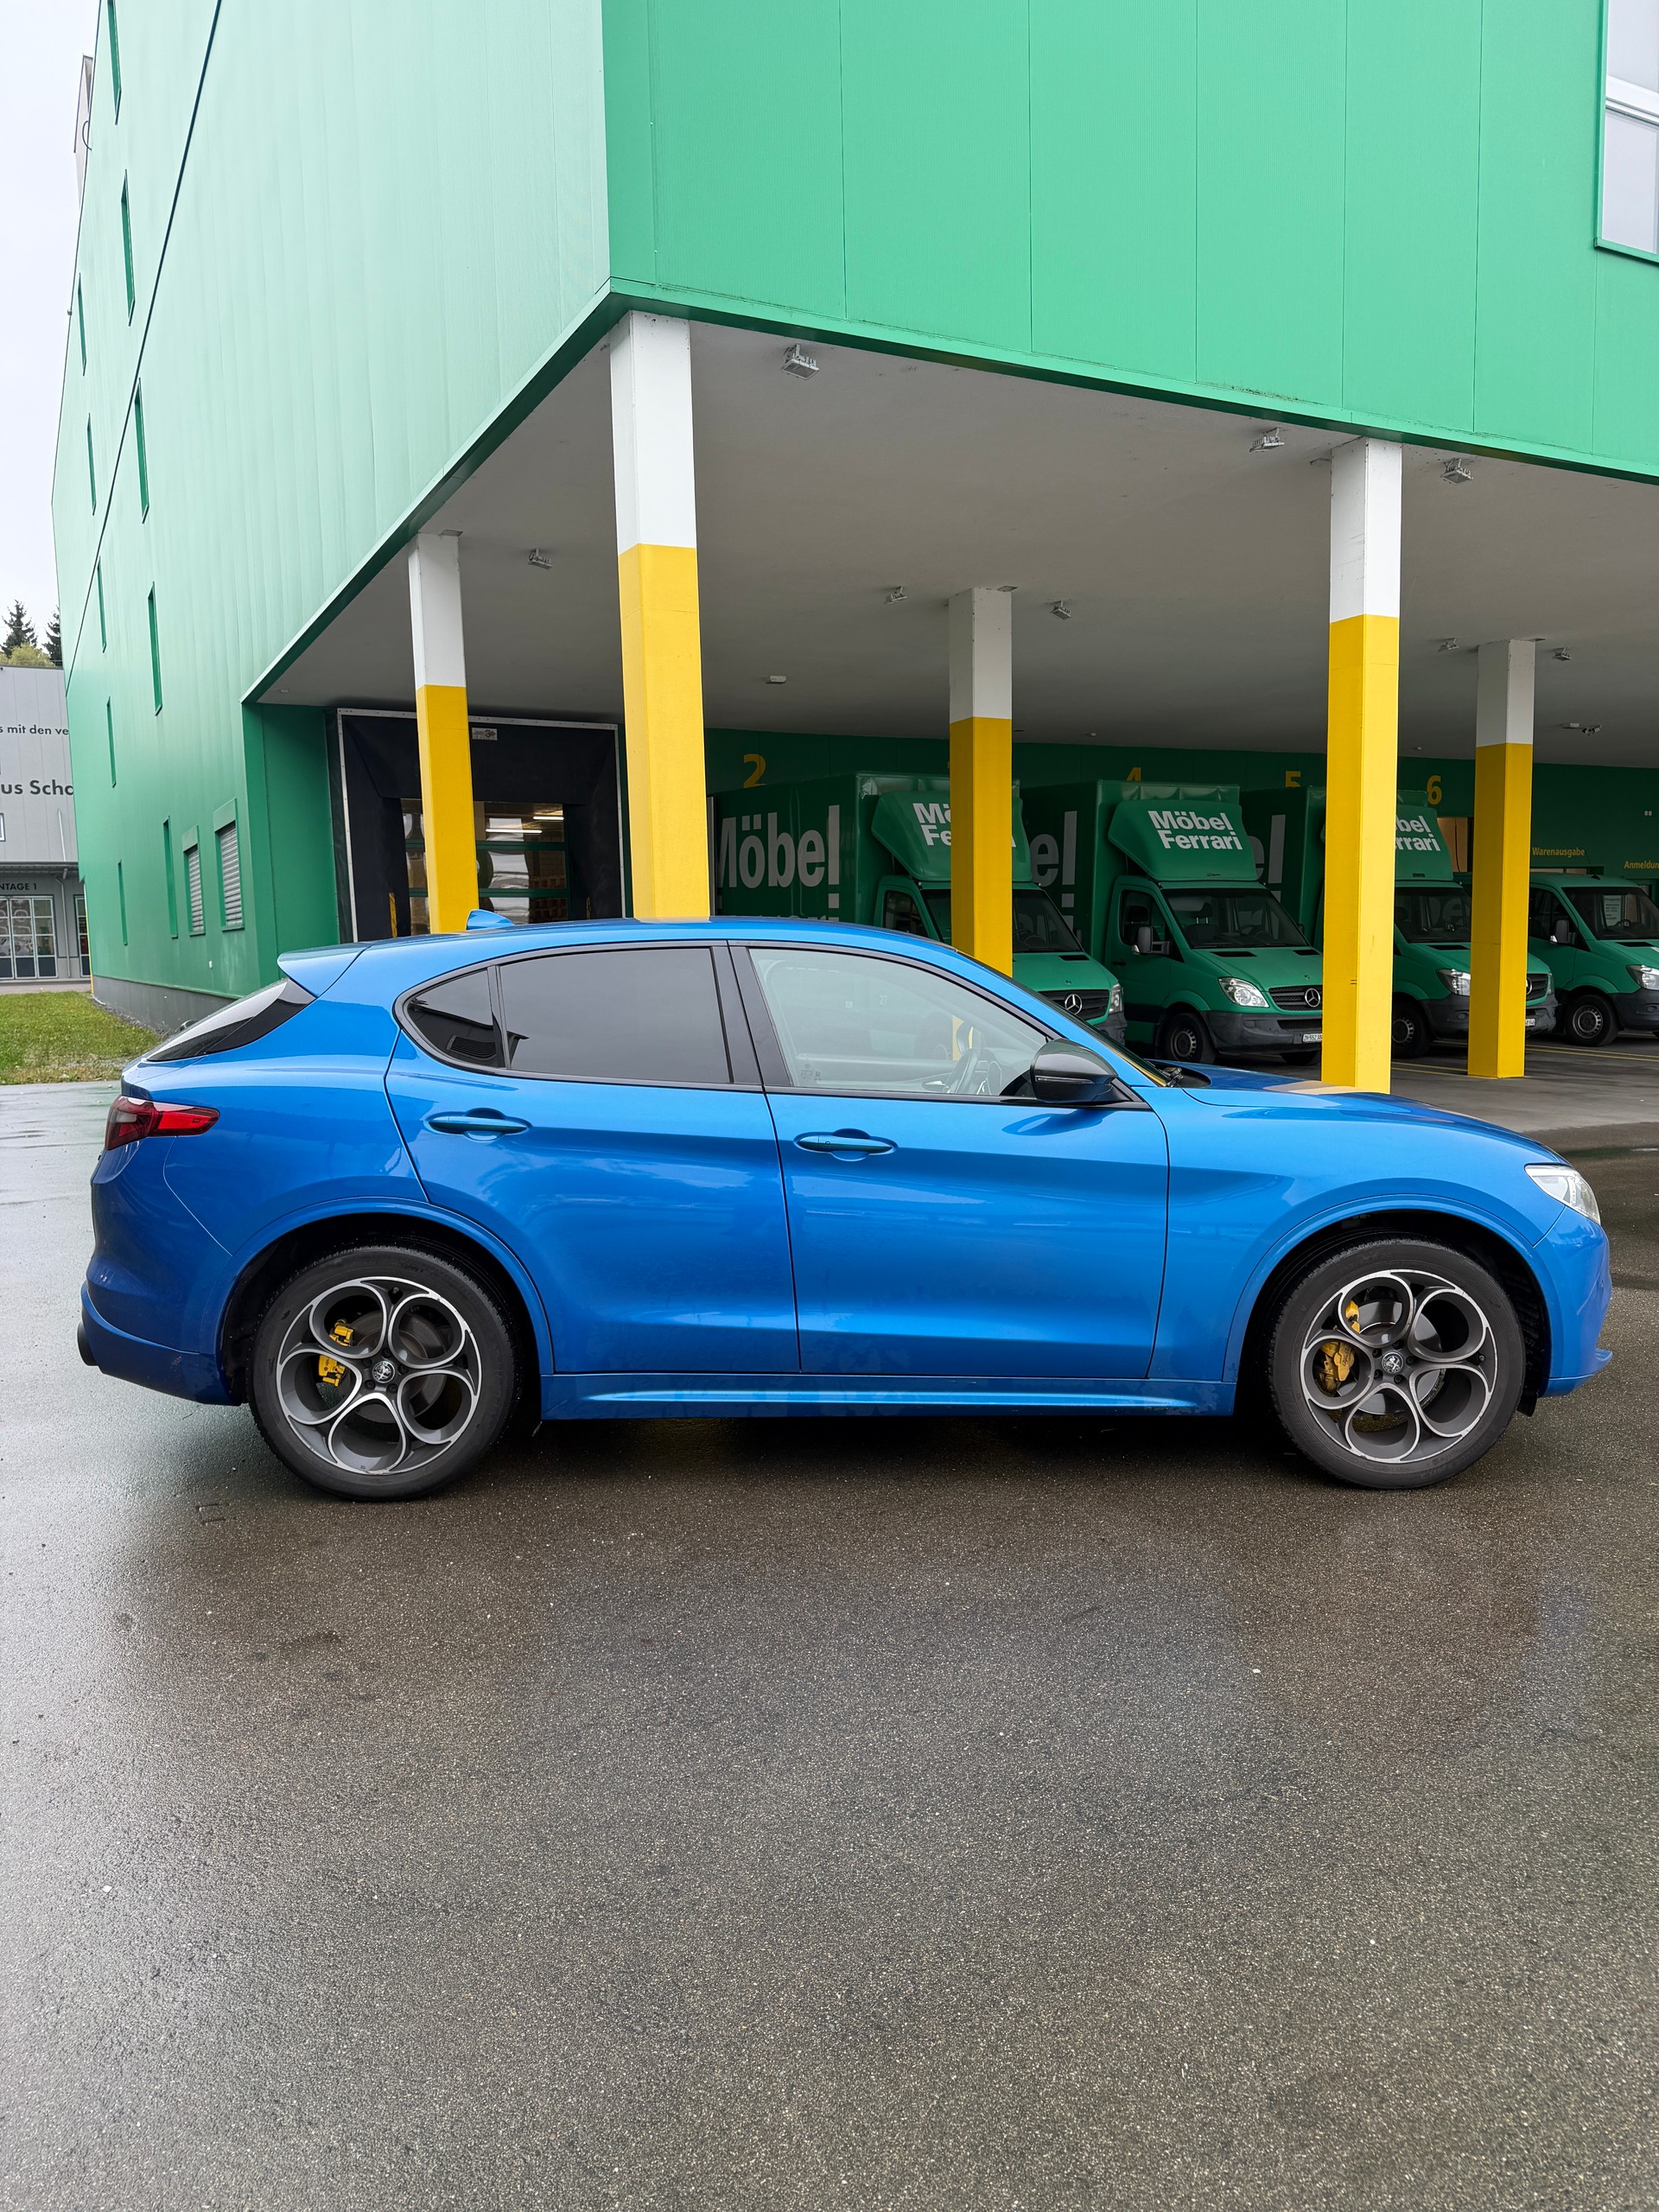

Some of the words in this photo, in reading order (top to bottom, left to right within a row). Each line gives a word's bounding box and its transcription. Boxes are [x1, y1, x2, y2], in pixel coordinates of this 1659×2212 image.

[7, 724, 27, 734] mit
[29, 724, 52, 734] den
[742, 753, 768, 789] 2
[1427, 775, 1442, 805] 6
[1147, 810, 1233, 831] Möbel
[1395, 815, 1432, 832] bel
[1156, 830, 1243, 850] Ferrari
[1395, 833, 1441, 851] rrari
[1532, 847, 1586, 858] Warenausgabe
[1624, 860, 1659, 869] Anmeldun
